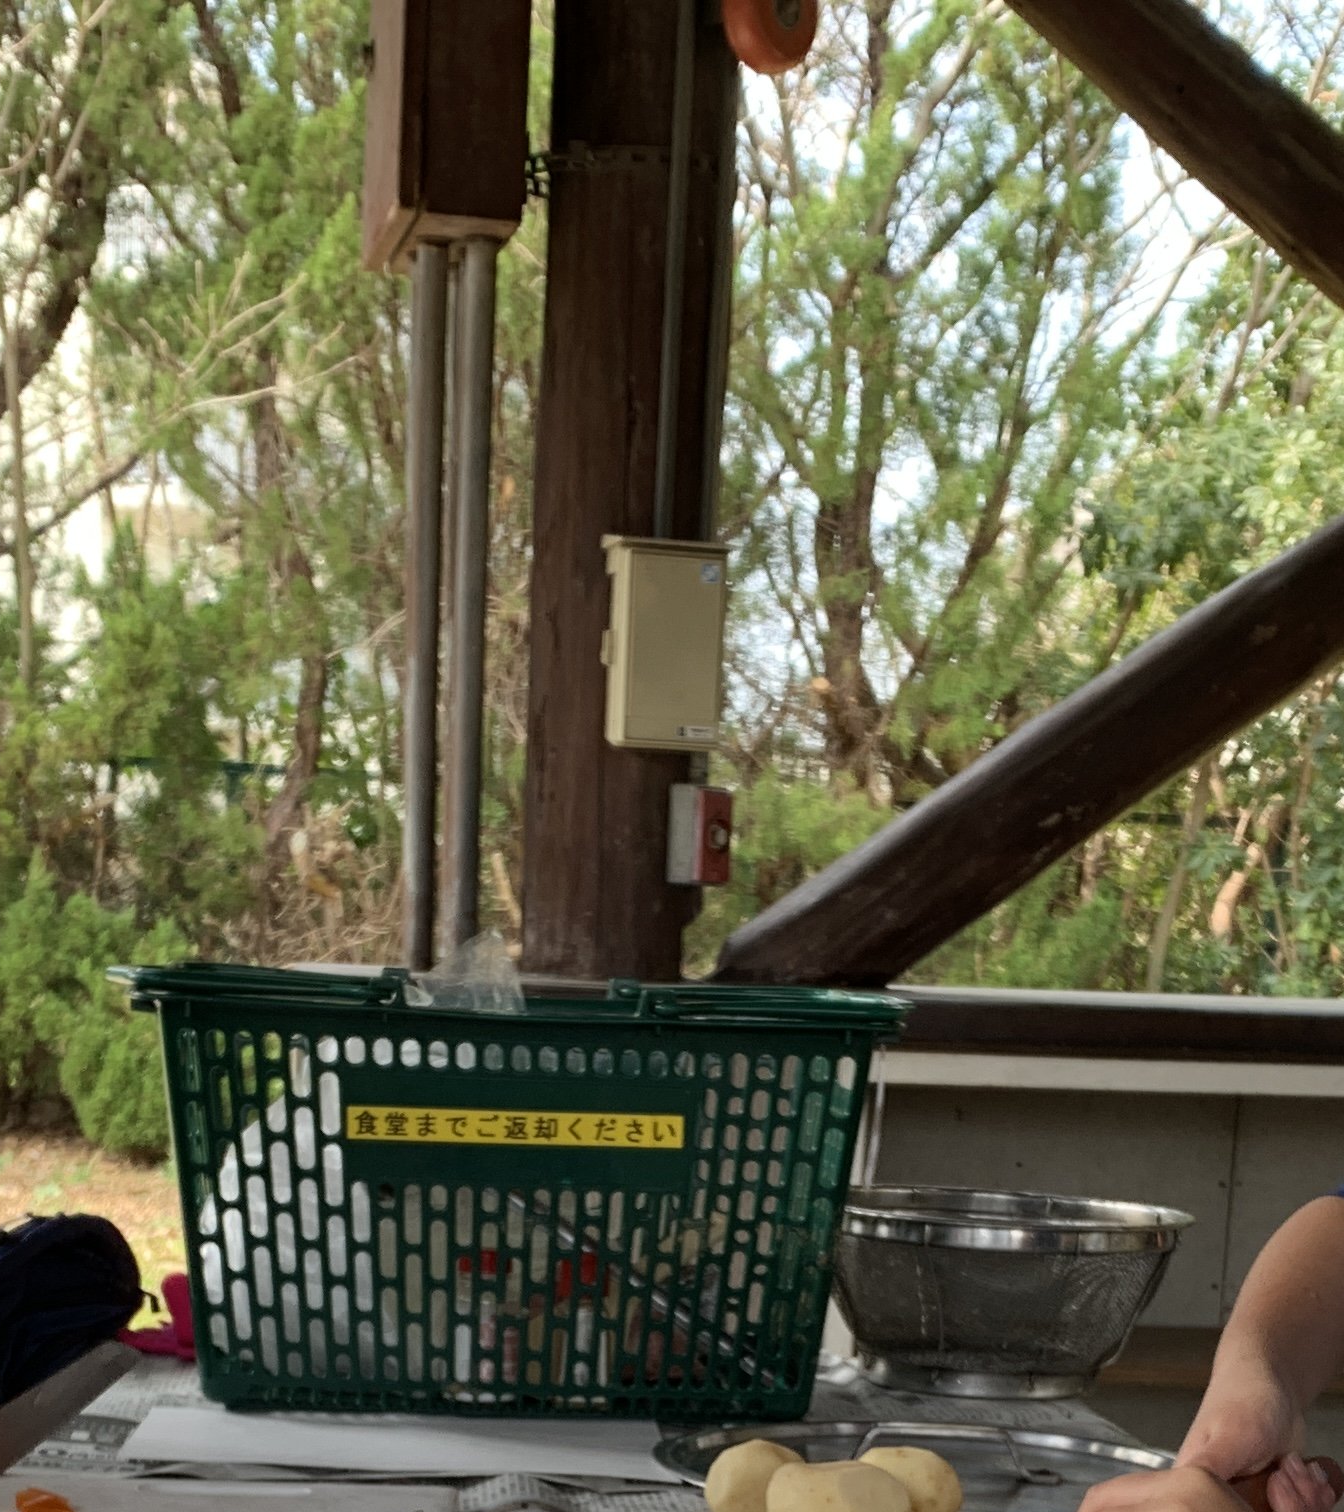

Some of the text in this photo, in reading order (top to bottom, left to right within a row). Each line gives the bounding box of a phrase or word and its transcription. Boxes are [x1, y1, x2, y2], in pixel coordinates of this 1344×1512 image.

[353, 1111, 677, 1144] 食堂までご返却ください
